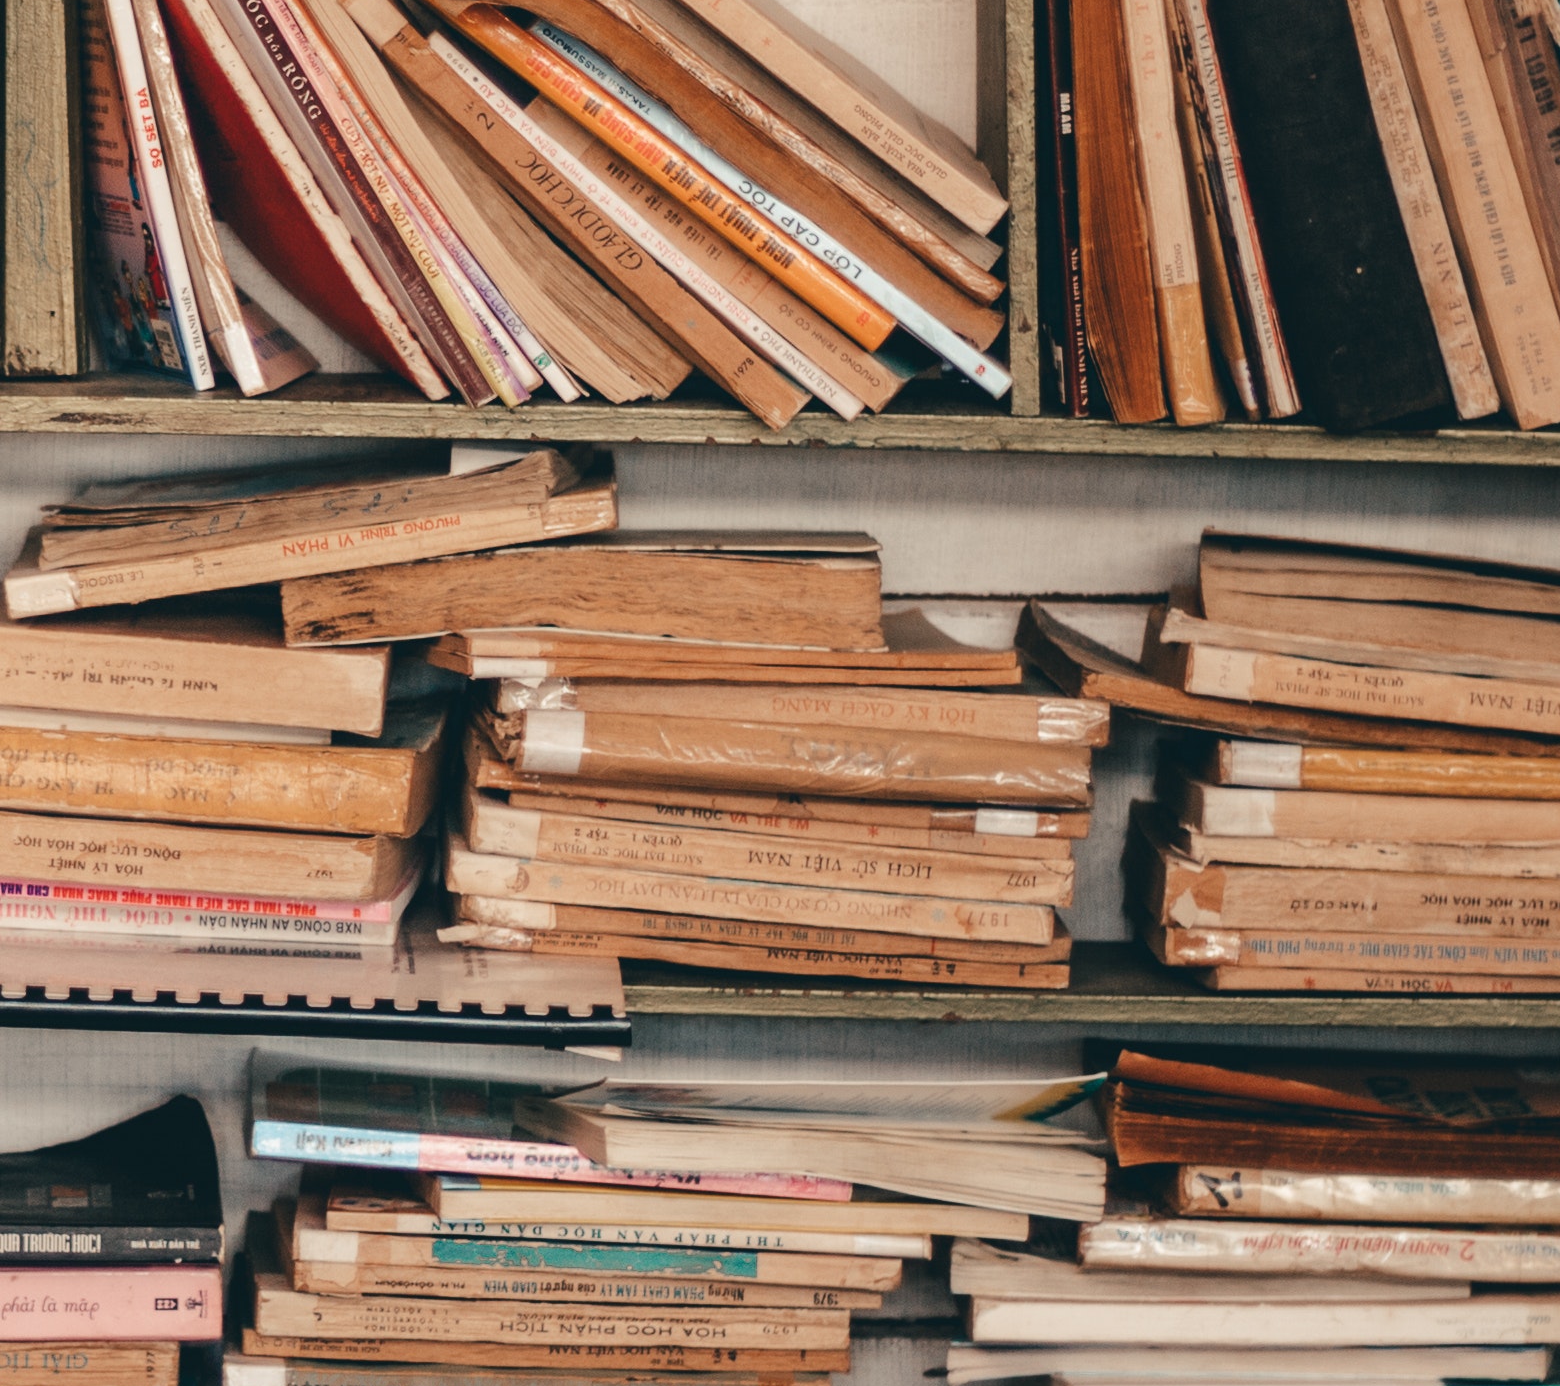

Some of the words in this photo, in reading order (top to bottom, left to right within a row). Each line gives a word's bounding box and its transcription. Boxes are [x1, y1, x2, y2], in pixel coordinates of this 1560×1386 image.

[263, 31, 289, 63] hóa
[280, 59, 326, 121] RỒNG
[184, 313, 203, 350] THANH
[731, 355, 755, 380] 1978
[401, 511, 461, 536] PHƯƠNG
[336, 531, 355, 548] VI
[359, 523, 398, 545] TRÌNH
[280, 535, 330, 561] PHÂN
[746, 849, 792, 866] NAM
[799, 851, 842, 875] VIỆT
[850, 857, 878, 879] SỬ
[886, 858, 932, 879] LỊCH
[1005, 872, 1038, 888] 1977
[197, 914, 227, 932] DÂN
[230, 915, 268, 933] NHÂN
[270, 917, 289, 931] AN
[292, 918, 332, 936] CÔNG
[334, 921, 362, 935] NXB
[41, 1294, 58, 1314] là
